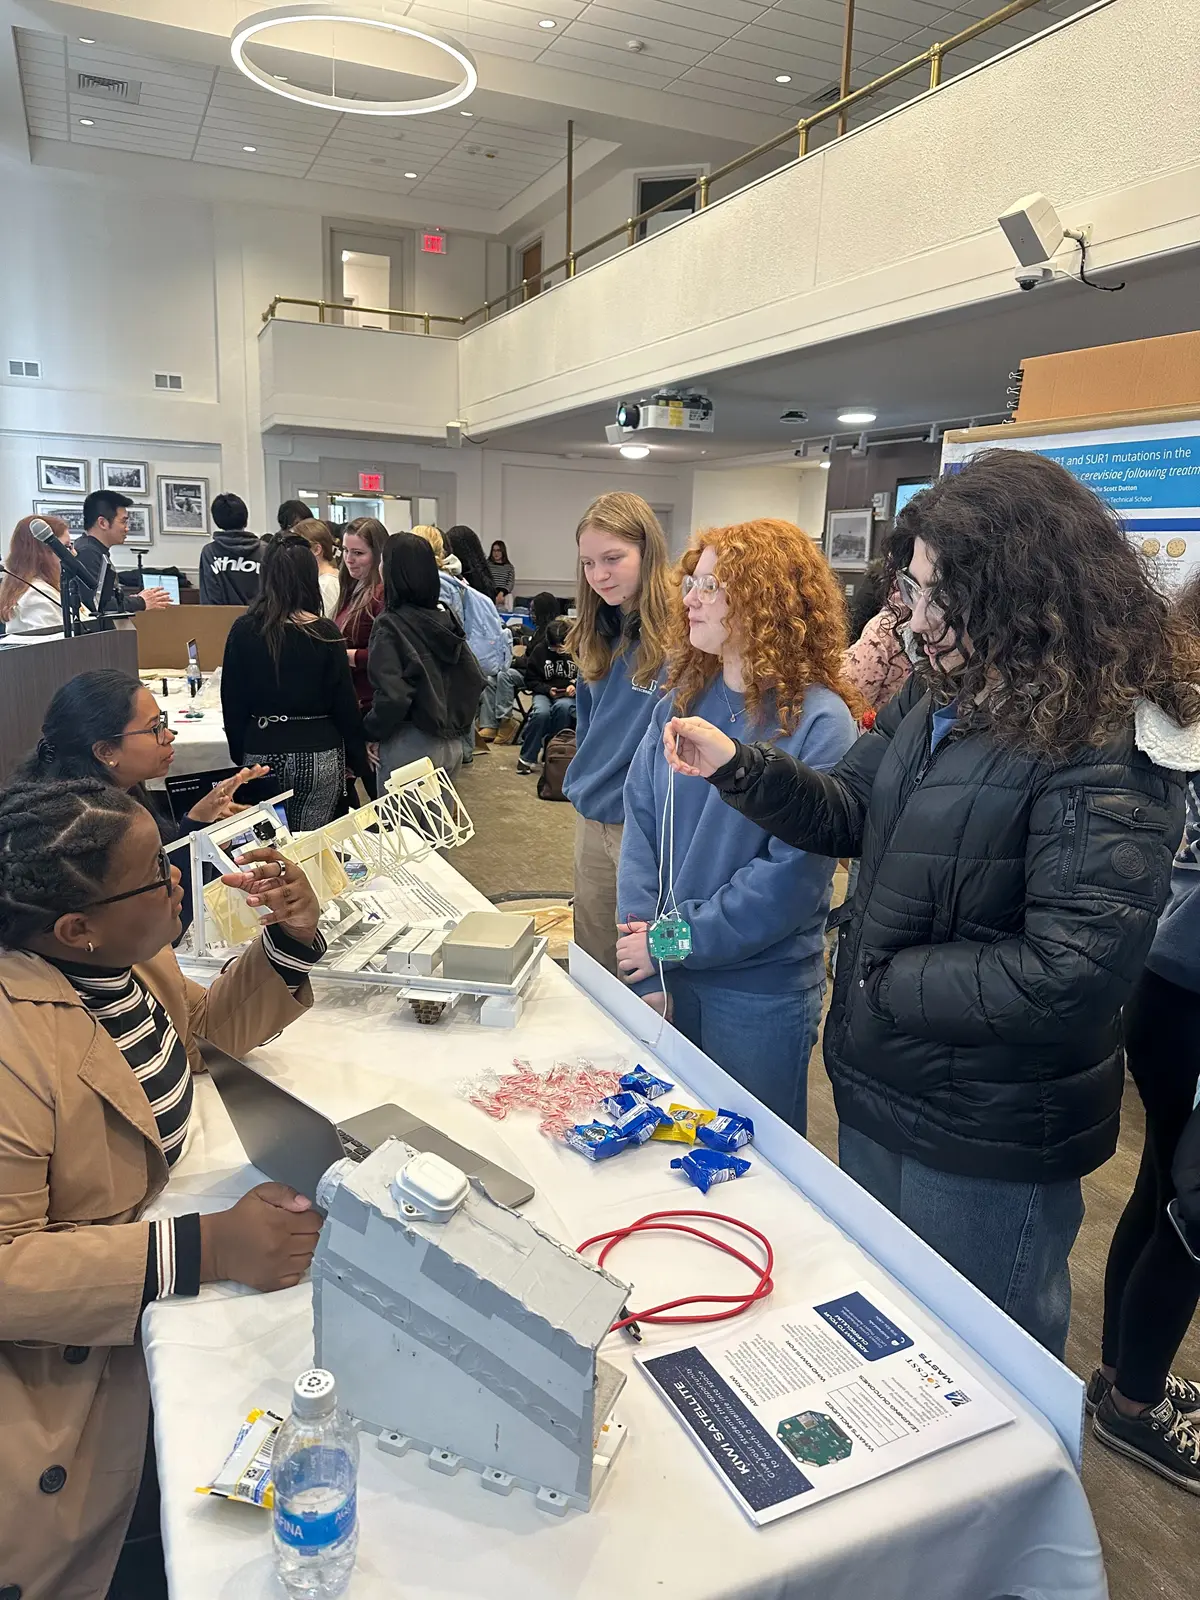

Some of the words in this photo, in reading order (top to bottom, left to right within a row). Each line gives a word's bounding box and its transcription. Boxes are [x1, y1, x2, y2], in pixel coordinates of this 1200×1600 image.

[1066, 455, 1082, 466] and
[1086, 454, 1108, 464] SUR1
[1112, 450, 1160, 462] mutations
[1163, 449, 1172, 459] in
[1174, 448, 1192, 458] the
[1080, 468, 1122, 481] cerevisiae
[1124, 466, 1166, 482] following
[544, 660, 576, 680] GAP
[696, 1369, 715, 1388] space
[810, 1367, 827, 1382] WHO
[684, 1367, 716, 1403] opportunity
[710, 1388, 726, 1401] into
[857, 1374, 891, 1405] OUTCOMES
[739, 1387, 759, 1407] ABOUT
[672, 1380, 726, 1442] SATELLITE
[712, 1403, 725, 1414] the
[722, 1401, 748, 1428] satellite
[823, 1400, 853, 1429] INCLUDED
[888, 1404, 920, 1433] LEARNING
[722, 1415, 750, 1445] students
[850, 1428, 875, 1452] WHAT'S
[745, 1444, 764, 1462] your
[748, 1434, 773, 1459] launch
[719, 1442, 751, 1474] KIWI
[769, 1459, 780, 1468] to
[758, 1461, 776, 1478] Give
